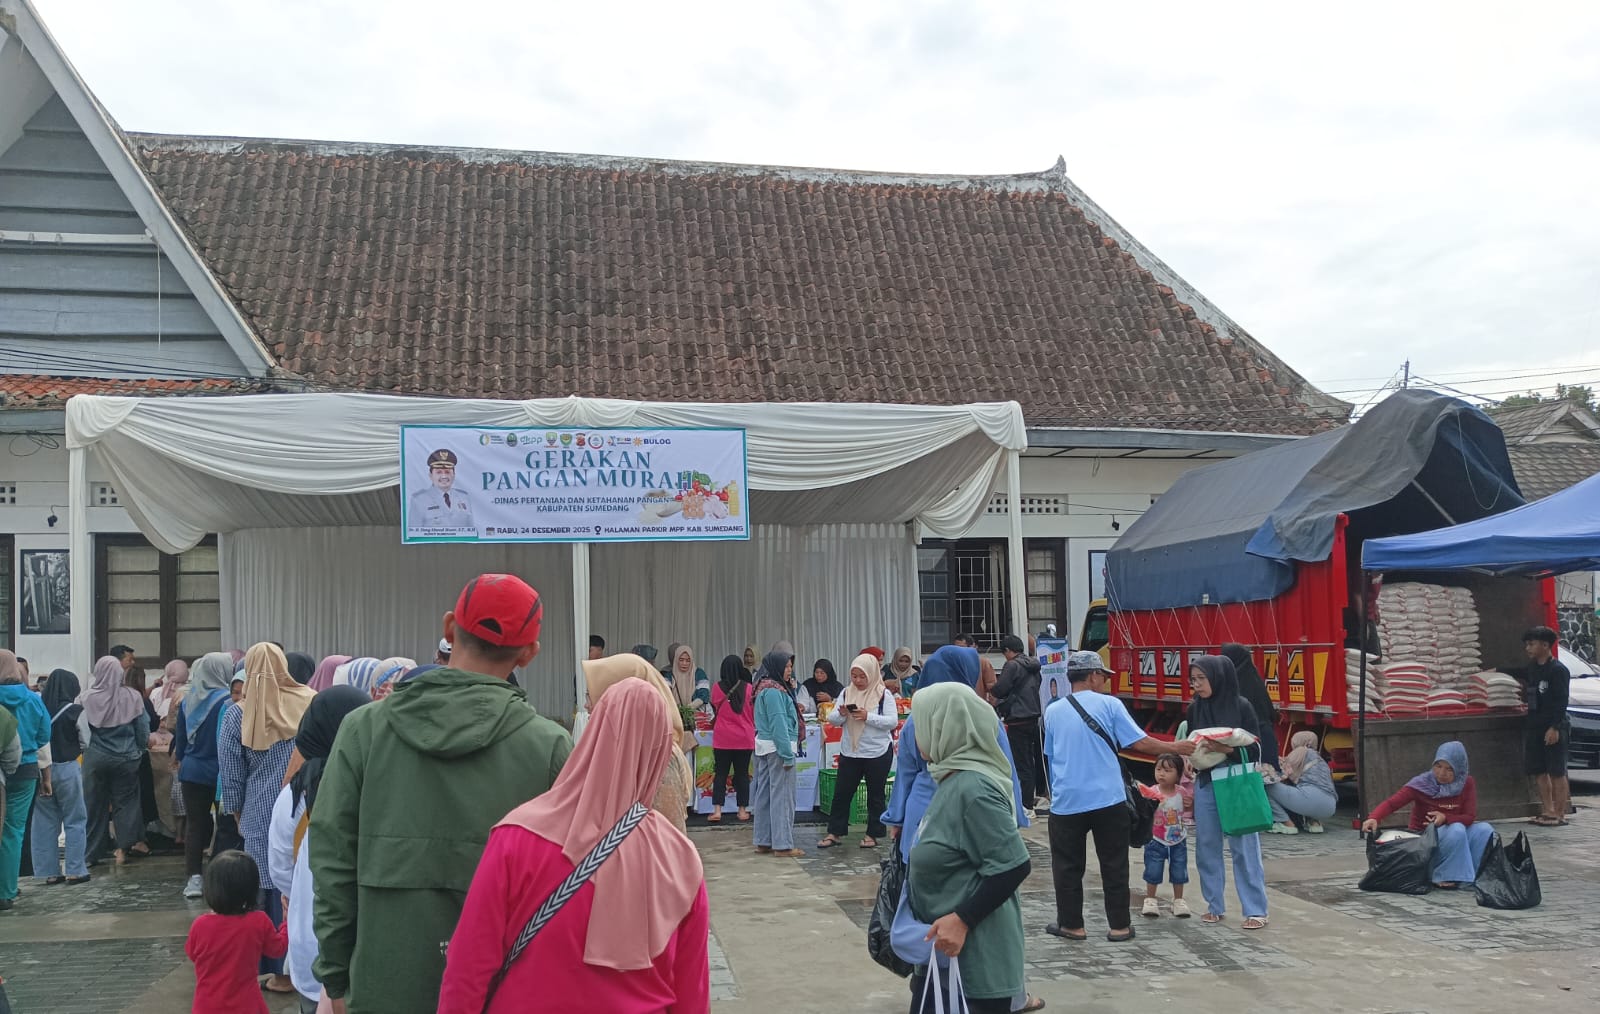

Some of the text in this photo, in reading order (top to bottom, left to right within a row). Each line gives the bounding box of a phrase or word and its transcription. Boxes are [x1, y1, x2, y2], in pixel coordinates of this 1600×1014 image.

[525, 449, 651, 469] GERAKAN
[481, 469, 692, 490] PANGAN MURAH
[521, 496, 566, 504] PERTANIAN
[587, 496, 634, 504] KETAHANAN
[585, 504, 630, 512] SUMEDANG
[497, 527, 519, 535] RABU,
